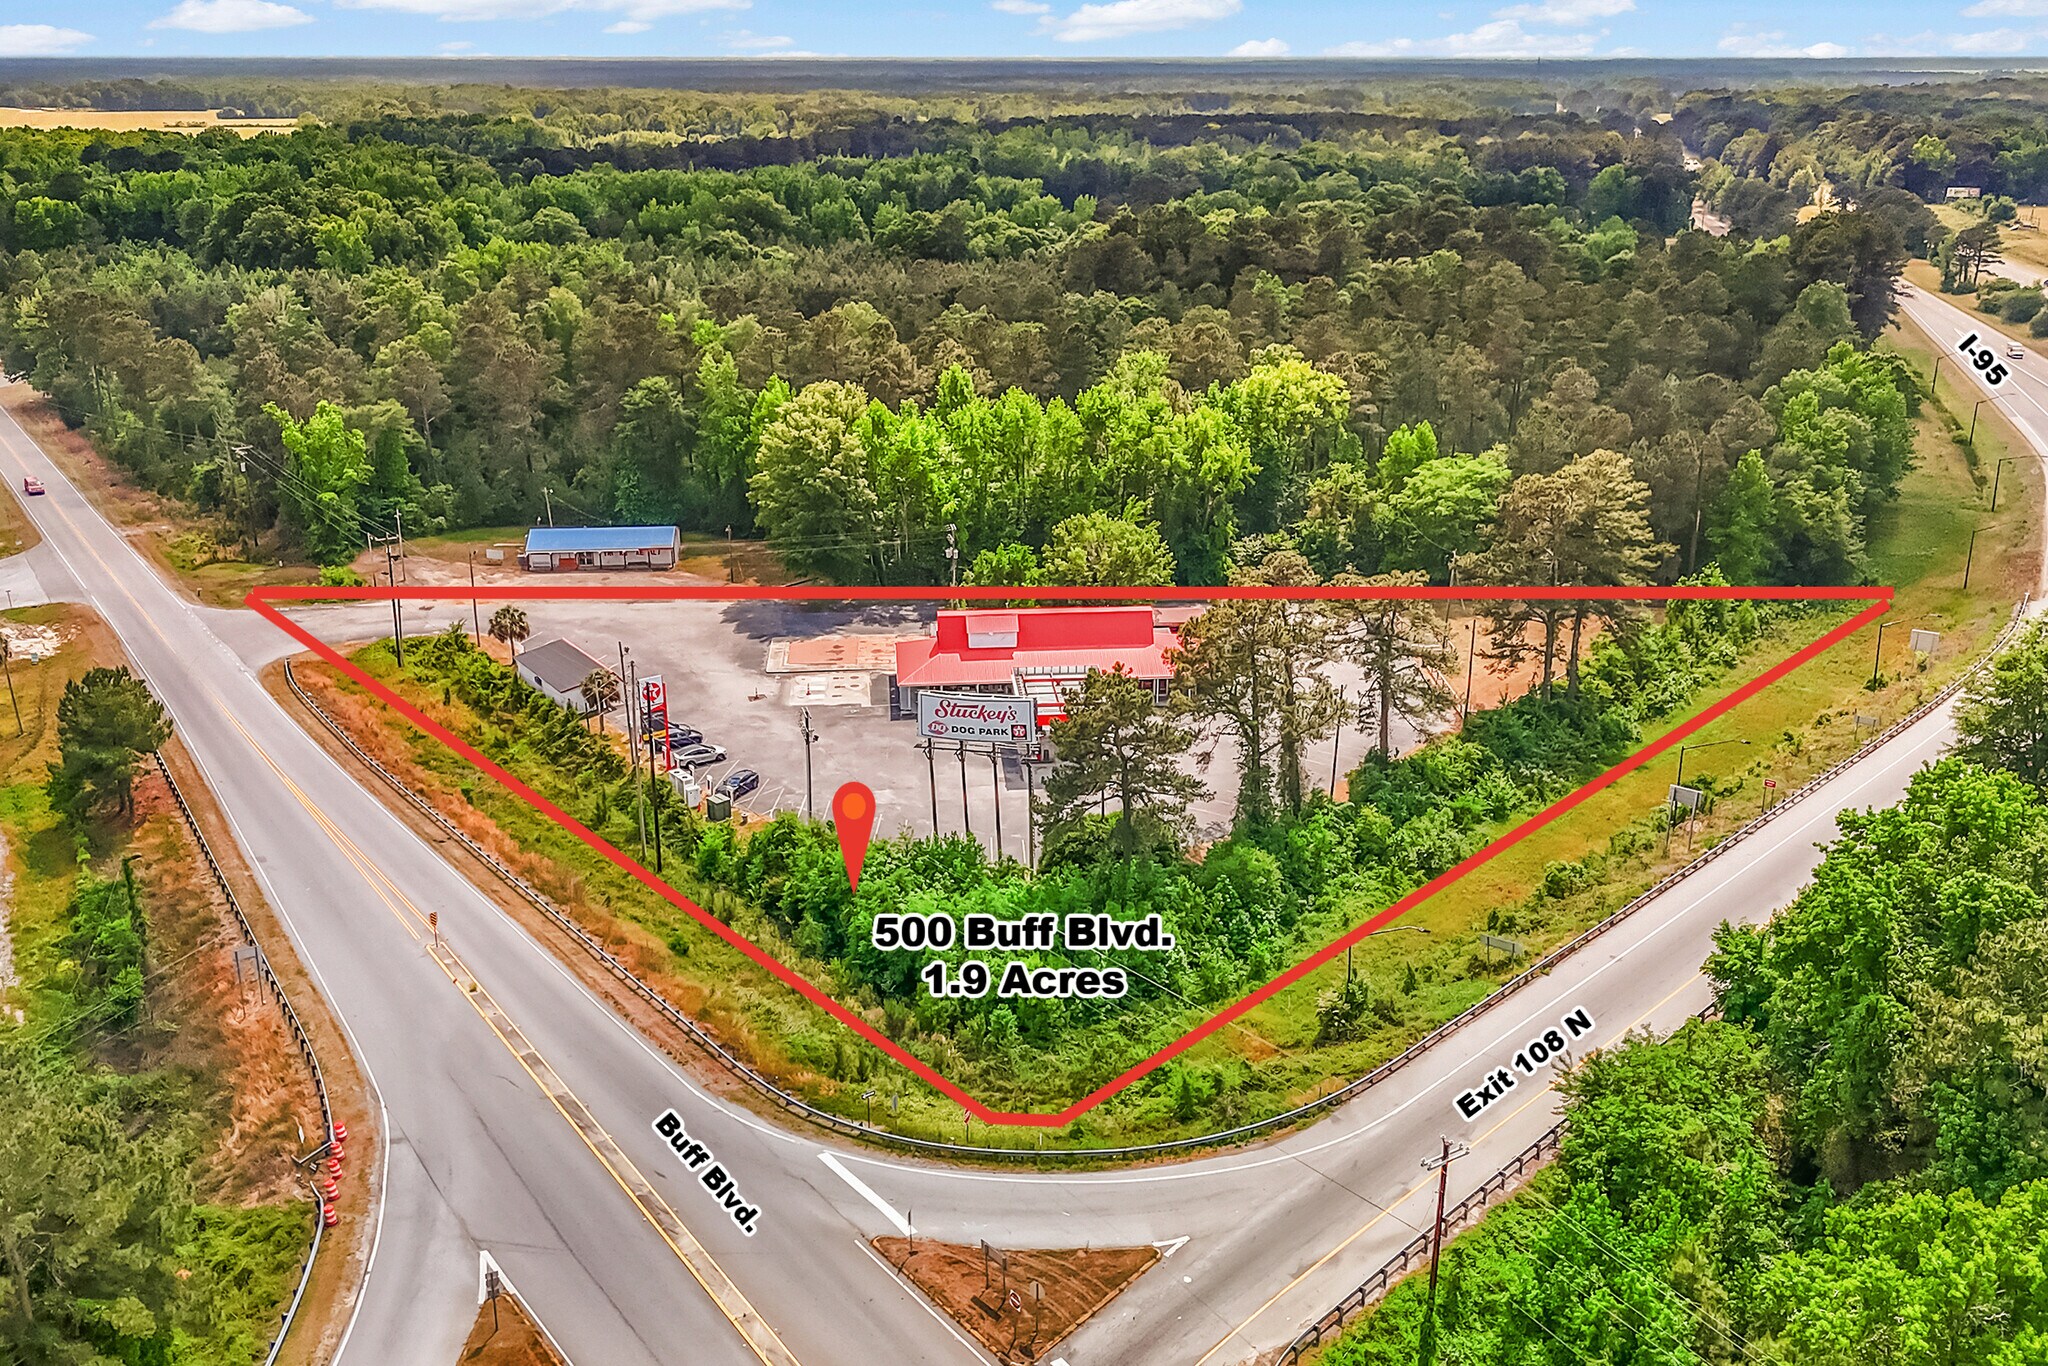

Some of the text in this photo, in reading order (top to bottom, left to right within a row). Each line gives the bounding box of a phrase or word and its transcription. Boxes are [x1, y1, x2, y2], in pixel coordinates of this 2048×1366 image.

[934, 699, 1017, 724] Stuckey's
[951, 725, 976, 735] DOG
[979, 727, 1009, 736] PARK
